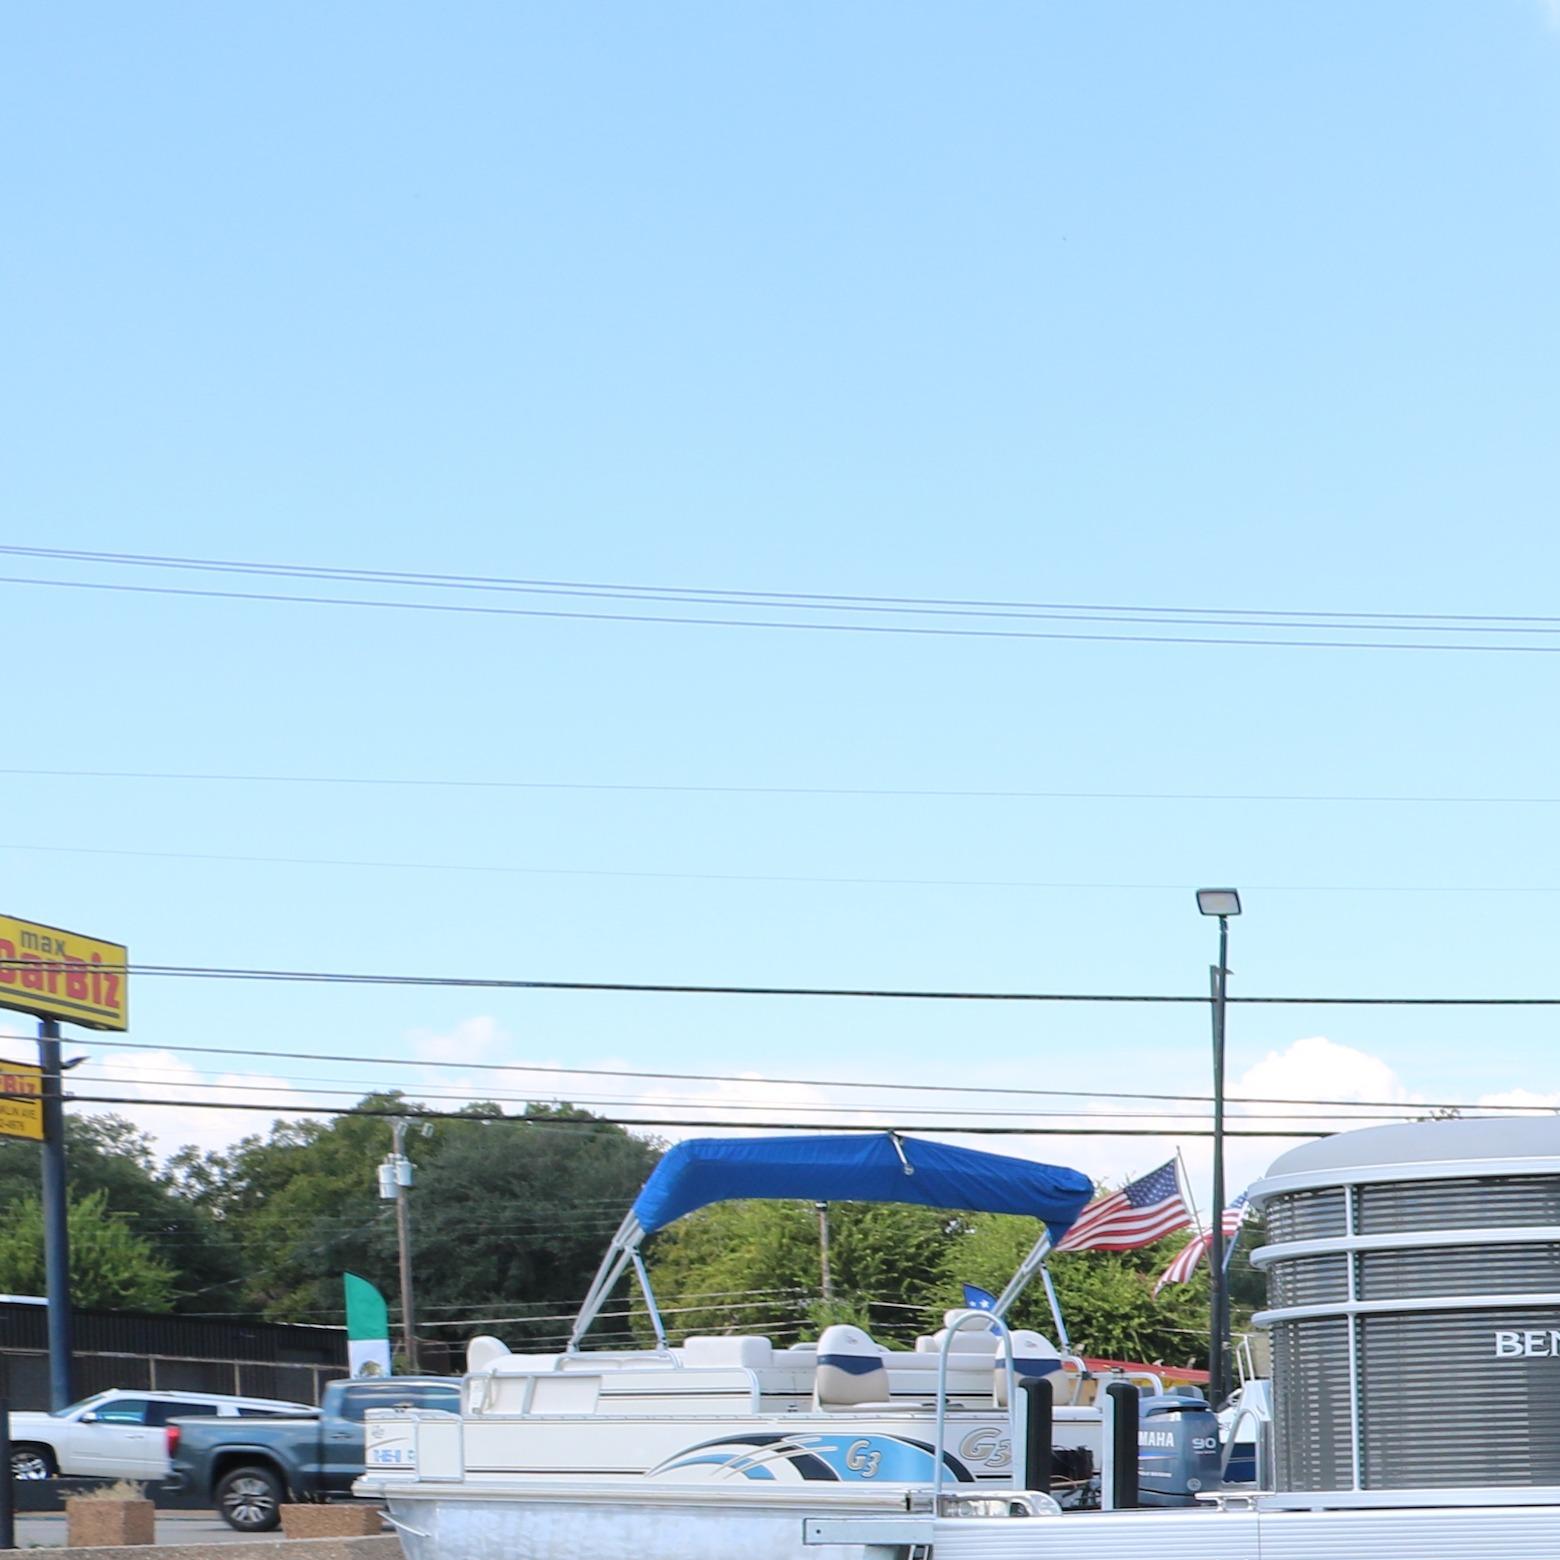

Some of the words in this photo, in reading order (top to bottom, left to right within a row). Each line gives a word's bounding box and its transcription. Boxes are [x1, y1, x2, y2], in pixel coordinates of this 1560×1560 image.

[21, 931, 65, 955] max
[958, 1427, 1012, 1468] G3
[1138, 1431, 1174, 1447] MAHA
[1191, 1437, 1217, 1450] 90
[846, 1438, 882, 1478] G3
